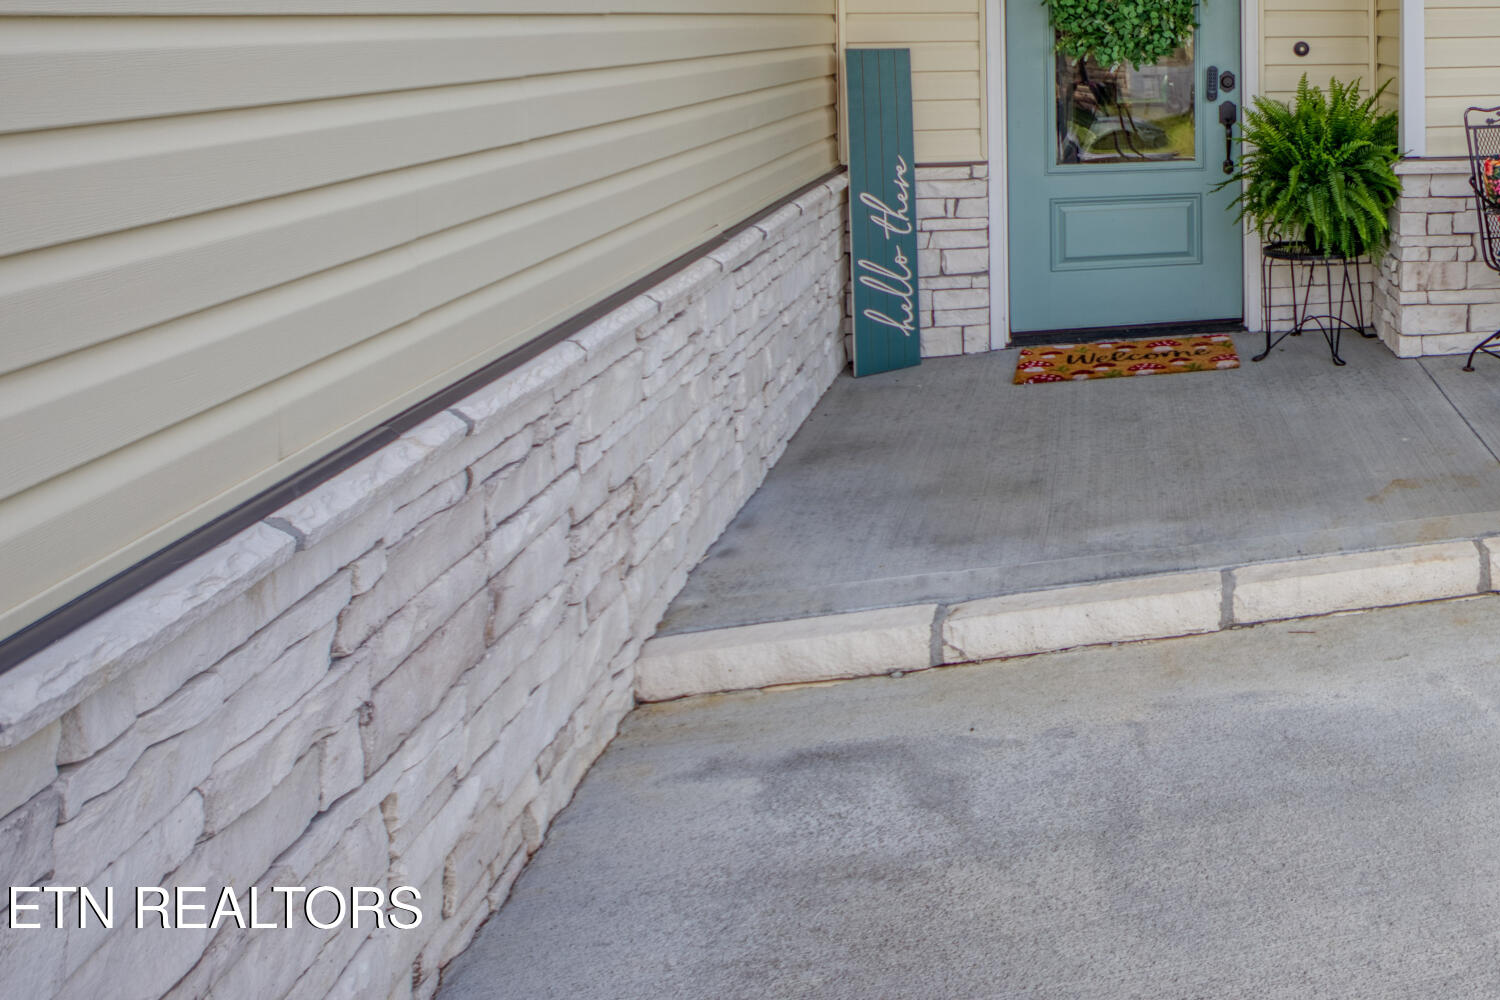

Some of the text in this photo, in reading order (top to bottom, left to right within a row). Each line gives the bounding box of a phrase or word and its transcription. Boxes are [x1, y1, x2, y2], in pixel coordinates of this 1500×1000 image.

[858, 154, 915, 336] hello there
[1066, 348, 1211, 365] Welcome
